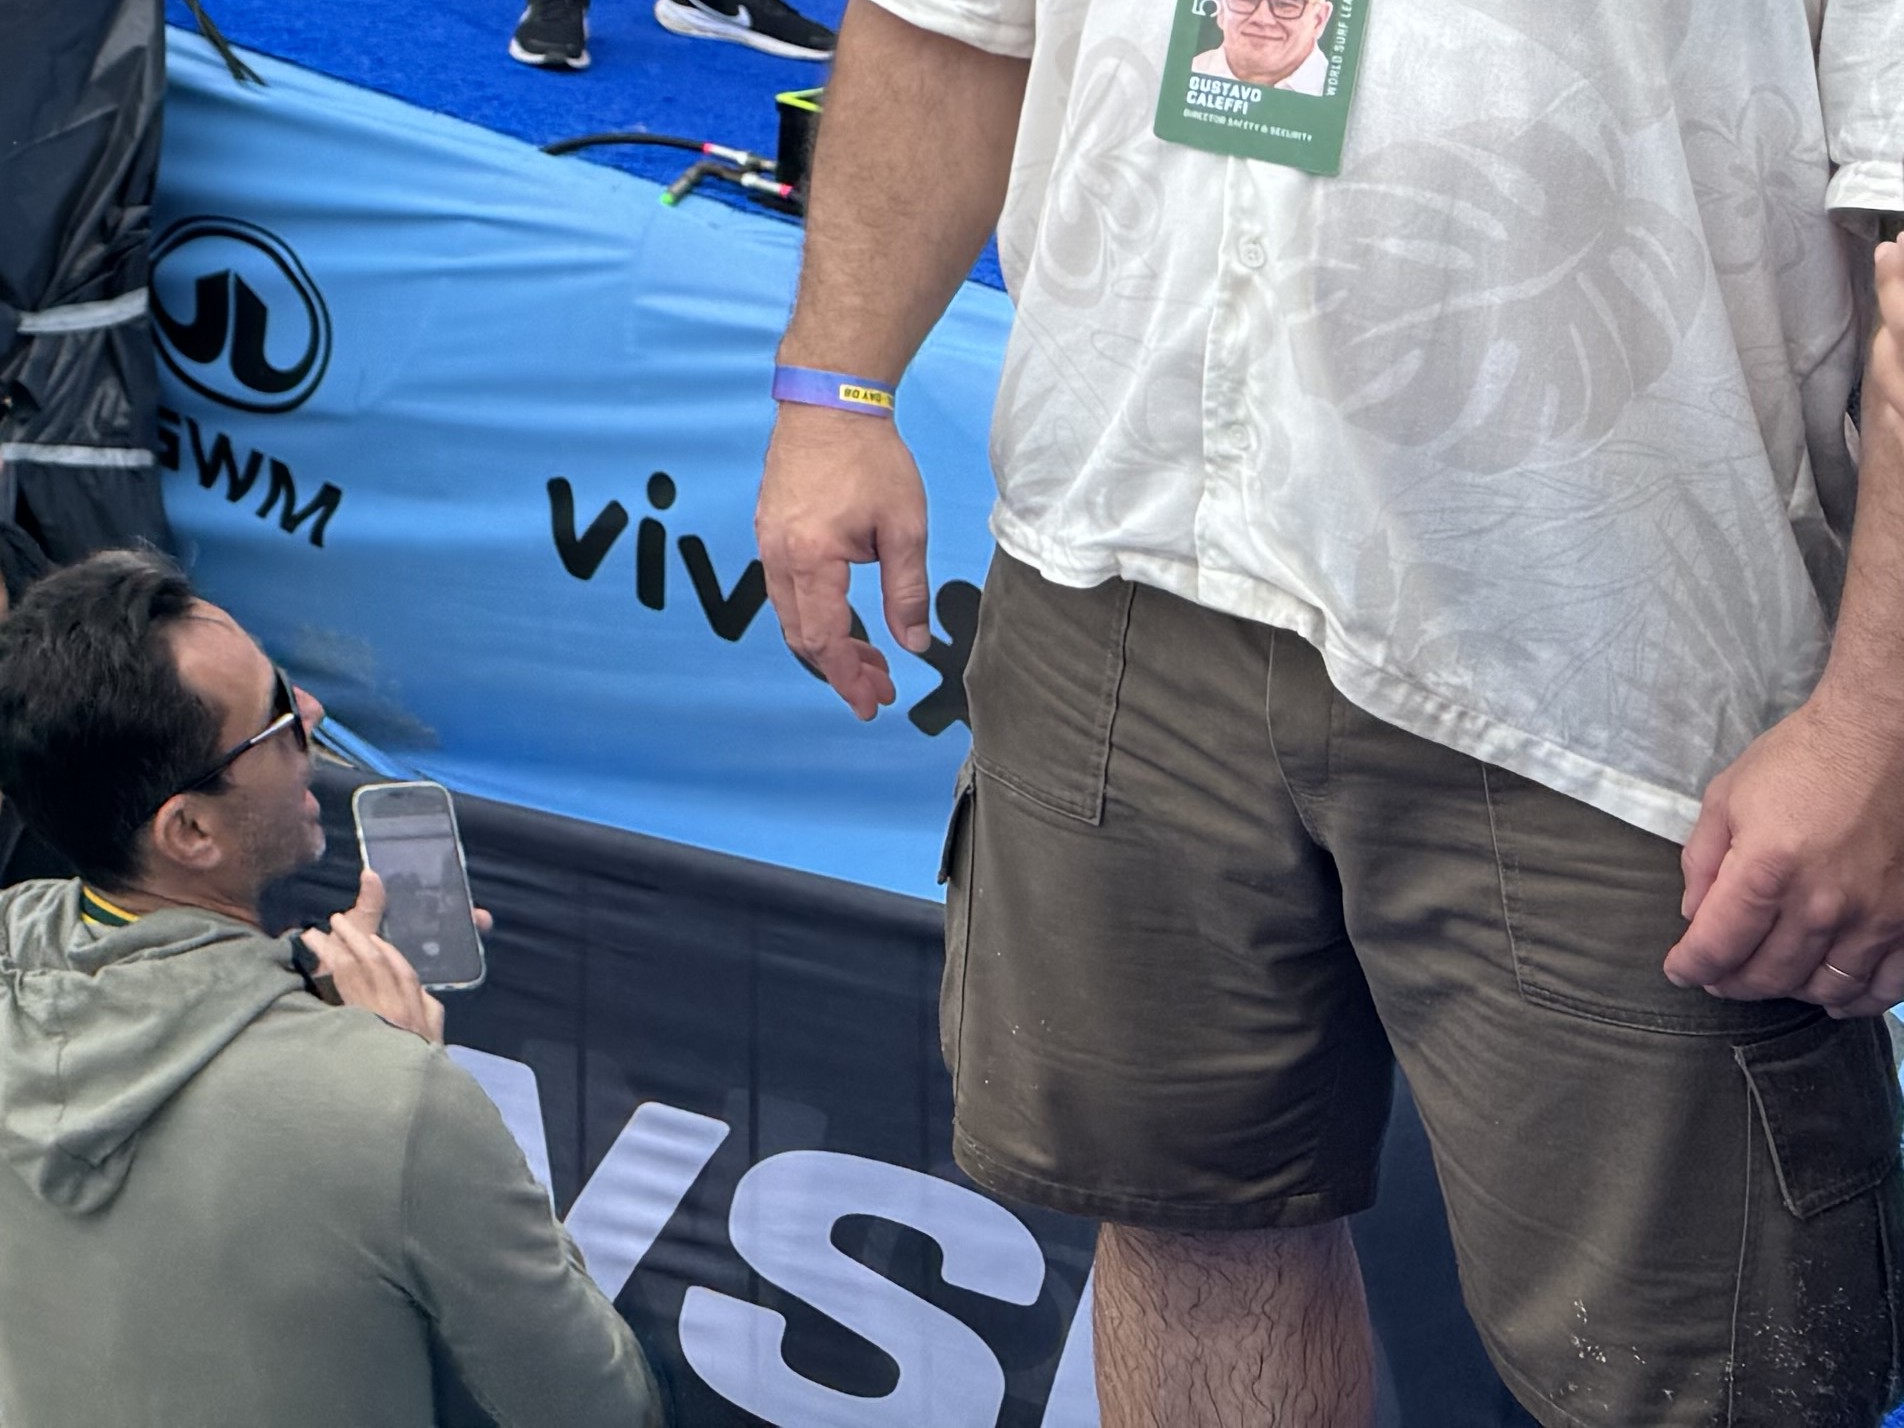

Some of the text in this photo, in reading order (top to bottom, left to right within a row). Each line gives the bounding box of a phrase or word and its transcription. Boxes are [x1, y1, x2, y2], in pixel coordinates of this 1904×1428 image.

[1334, 20, 1349, 54] SURF
[1189, 75, 1262, 103] GUSTAVO
[1327, 54, 1344, 96] WORLD
[1186, 91, 1249, 115] CALEFFI
